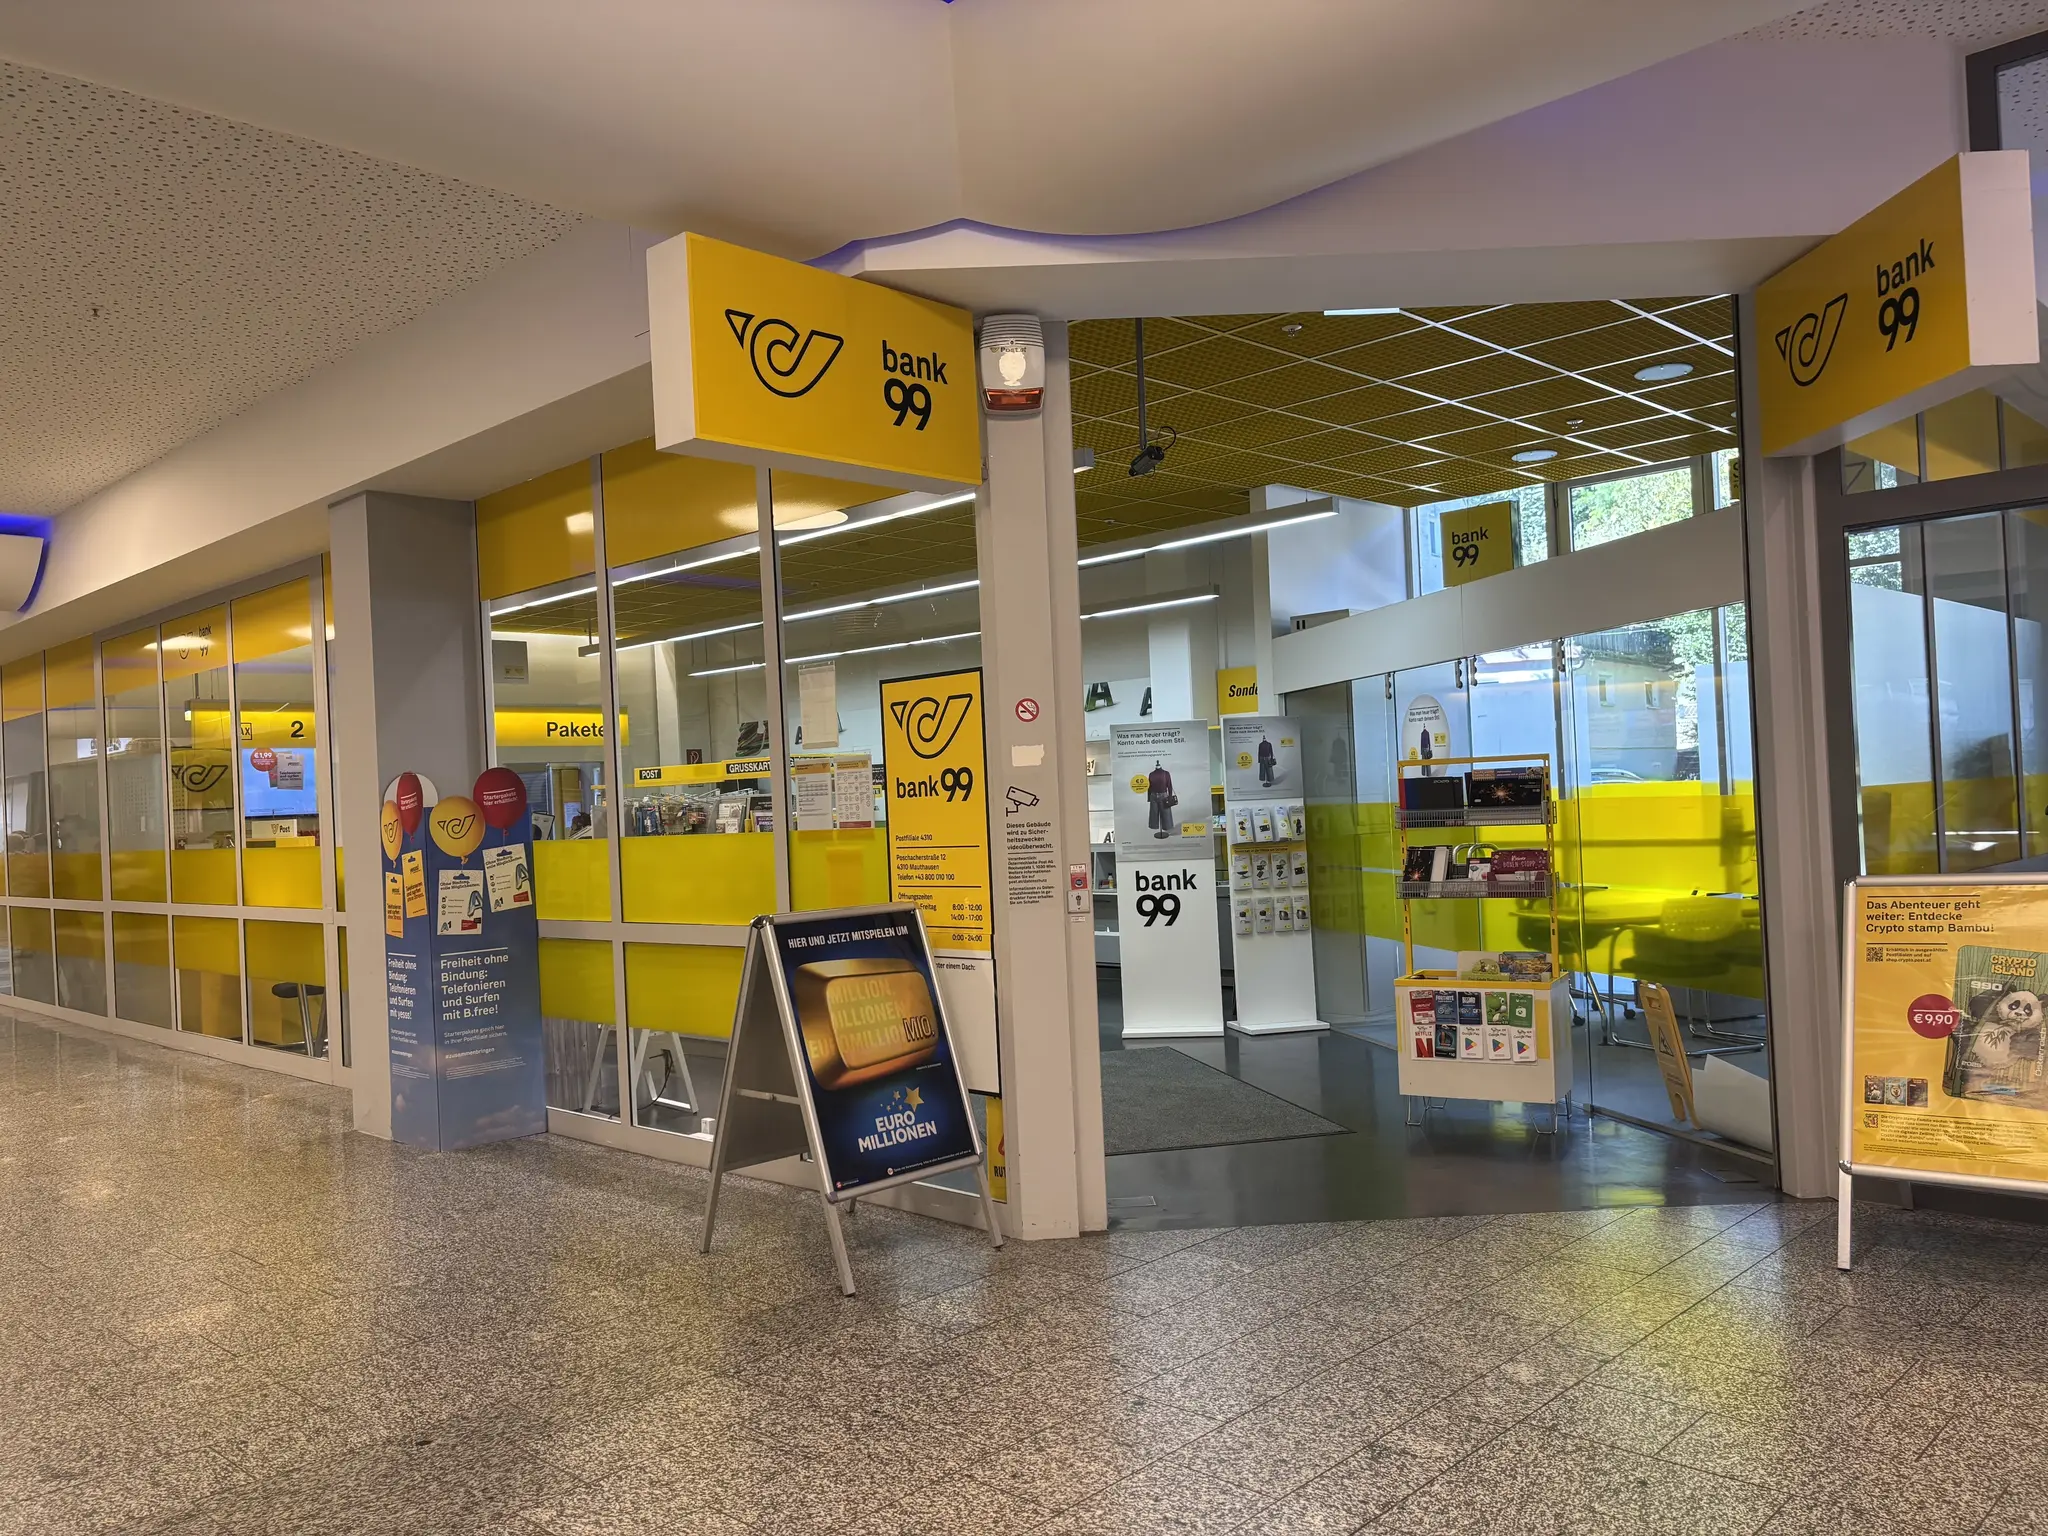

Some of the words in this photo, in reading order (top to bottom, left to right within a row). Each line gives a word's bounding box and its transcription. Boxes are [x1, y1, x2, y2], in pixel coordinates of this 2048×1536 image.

[1875, 238, 1935, 299] bank
[1878, 286, 1921, 353] 99
[881, 339, 949, 385] bank
[883, 377, 932, 432] 99
[1452, 526, 1489, 545] bank
[1452, 544, 1480, 568] 99
[290, 720, 305, 738] 2
[641, 769, 659, 779] POST
[896, 863, 909, 871] 4310
[1135, 868, 1197, 892] bank
[897, 891, 933, 901] Öffnungszeiten
[952, 903, 964, 911] 8:00
[968, 903, 983, 911] 12:00
[1136, 893, 1181, 927] 99
[1866, 900, 1888, 910] Das
[1890, 900, 1951, 910] Abenteuer
[1954, 900, 1981, 911] geht
[950, 913, 964, 921] 14:00
[968, 914, 983, 922] 17:00
[1866, 911, 1905, 921] weiter:
[1908, 911, 1963, 921] Entdecke
[440, 920, 452, 932] A1
[1865, 923, 1905, 935] Crypto
[1907, 924, 1944, 934] stamp
[1948, 923, 1995, 933] Bambu!
[788, 937, 808, 949] HIER
[808, 935, 826, 946] UND
[827, 932, 851, 944] JETZT
[851, 928, 895, 942] MITSPIELEN
[896, 925, 909, 936] UM
[952, 933, 964, 942] 0:00
[967, 934, 983, 942] 24:00
[388, 957, 404, 970] Freiheit
[404, 961, 417, 970] ohne
[440, 955, 482, 970] Freiheit
[483, 953, 509, 965] ohne
[1990, 954, 2038, 969] CRYPTO
[441, 969, 488, 983] Bindung:
[1991, 963, 2035, 978] ISLAND
[389, 982, 417, 996] Telefonieren
[441, 980, 506, 995] Telefonieren
[1970, 980, 2003, 991] 990
[389, 997, 398, 1006] und
[397, 996, 413, 1008] Surfen
[442, 996, 463, 1008] und
[465, 992, 500, 1005] Surfen
[442, 1010, 461, 1021] mit
[463, 1004, 499, 1018] B.free!
[875, 1110, 916, 1133] EURO
[857, 1120, 938, 1153] MILLIONEN
